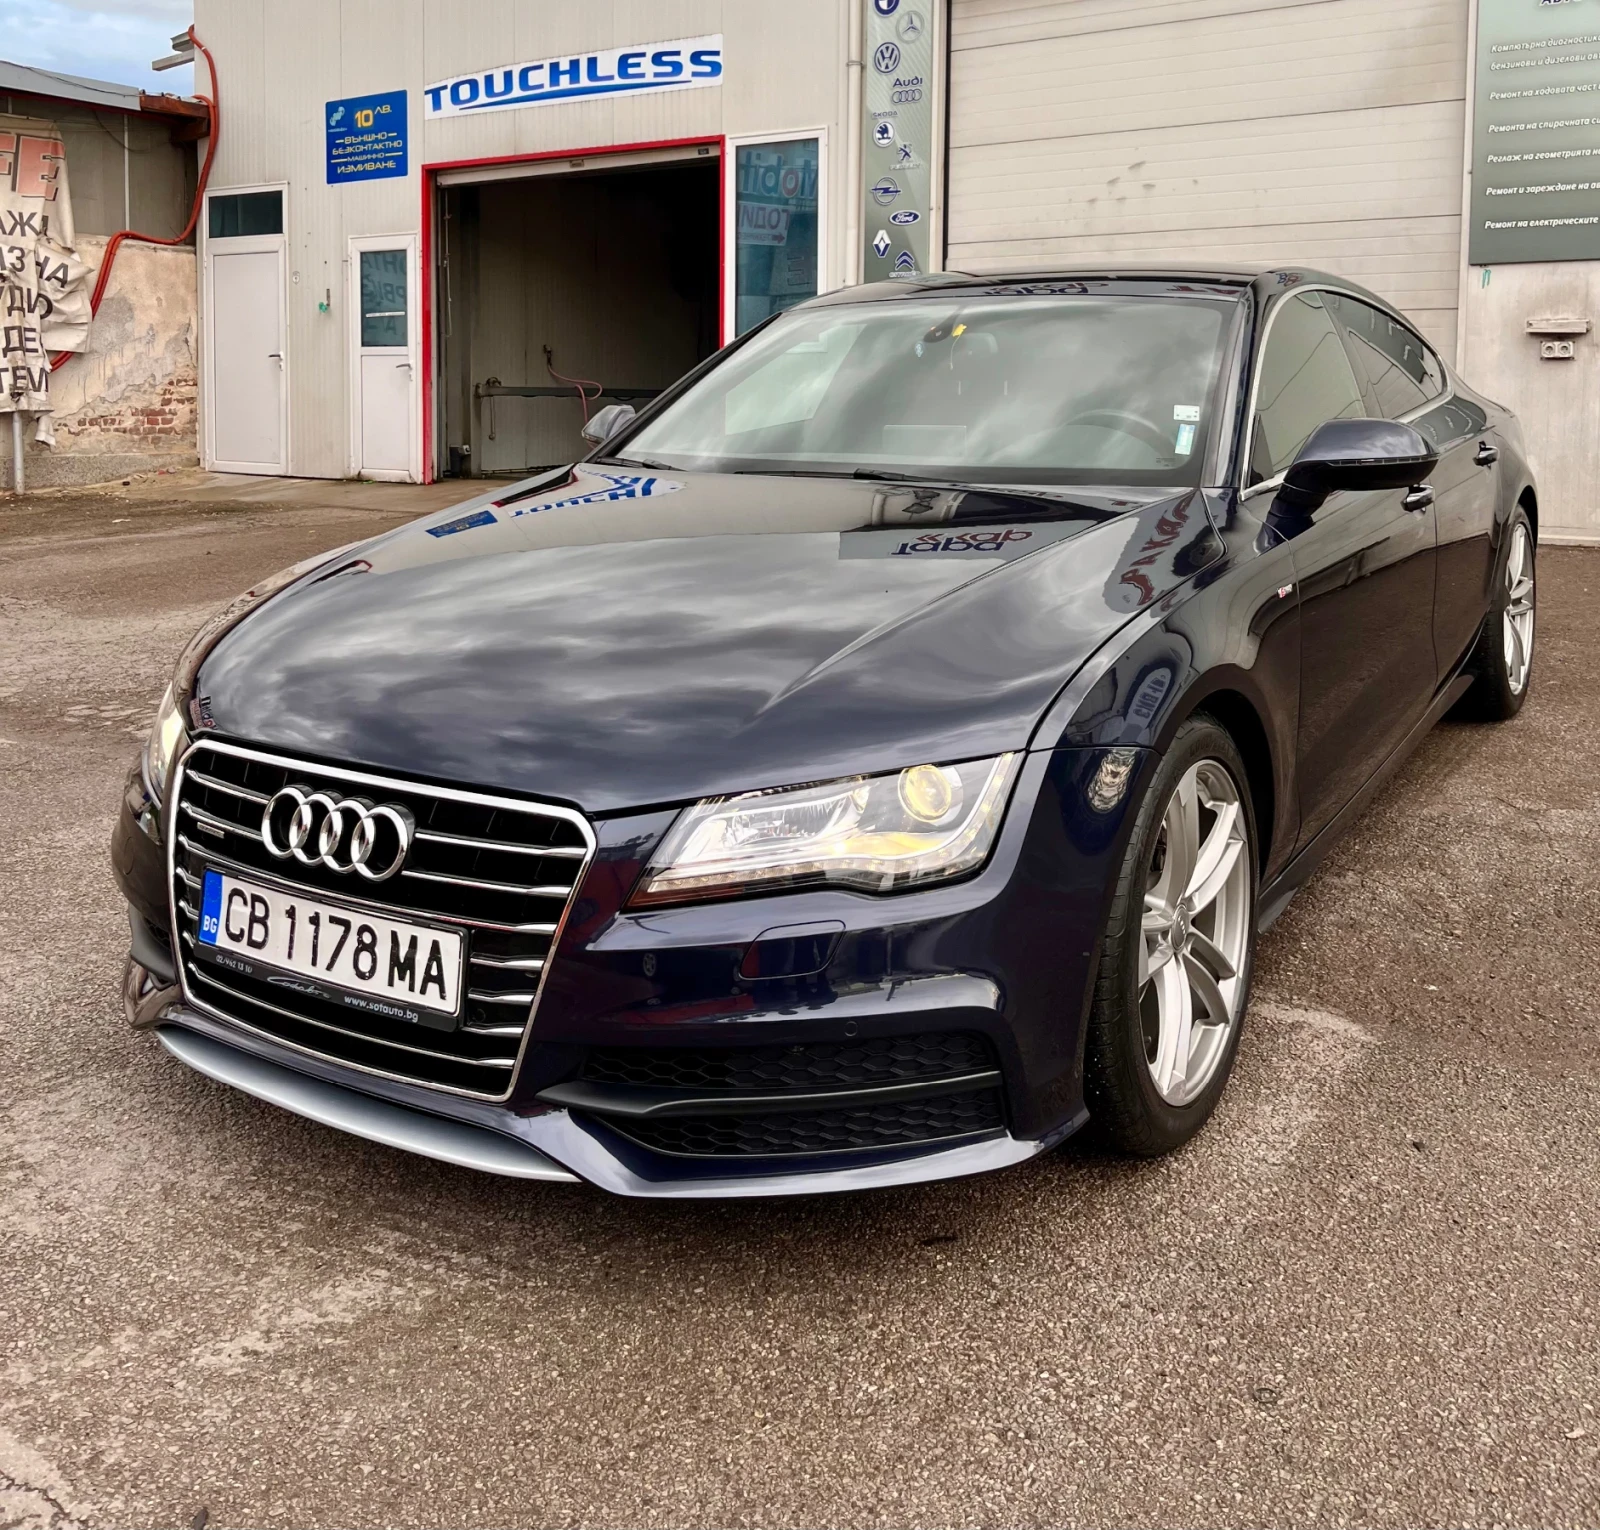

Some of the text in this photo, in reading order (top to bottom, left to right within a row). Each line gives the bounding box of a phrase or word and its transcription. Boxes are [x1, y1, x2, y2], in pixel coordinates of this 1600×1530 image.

[1491, 41, 1546, 53] Компютърна
[1490, 60, 1536, 70] бензинови
[1544, 55, 1586, 65] дизелови
[1587, 52, 1600, 60] ав
[424, 50, 722, 112] TOUCHLESS
[893, 75, 922, 88] Audi
[1489, 91, 1521, 100] Ремонт
[1535, 85, 1575, 96] ходовата
[1577, 84, 1597, 92] част
[355, 109, 373, 128] 10
[1488, 123, 1525, 133] Ремонта
[1538, 118, 1590, 129] спирачната
[344, 132, 387, 145] ВЪНШНО
[332, 140, 402, 155] БЕЗКОНТАКТНО
[347, 152, 384, 162] МАШИННО
[1487, 154, 1521, 163] Реглаж
[1535, 149, 1591, 159] геометрията
[337, 160, 396, 174] ИЗМИВАНЕ
[1486, 187, 1518, 196] Ремонт
[1525, 183, 1577, 194] зареждане
[1578, 182, 1589, 190] на
[1485, 216, 1599, 229] Ремонт на електрическите
[203, 914, 218, 934] BG
[225, 887, 447, 1001] CB 1178 MA
[344, 995, 419, 1023] www.sotauto.bg
